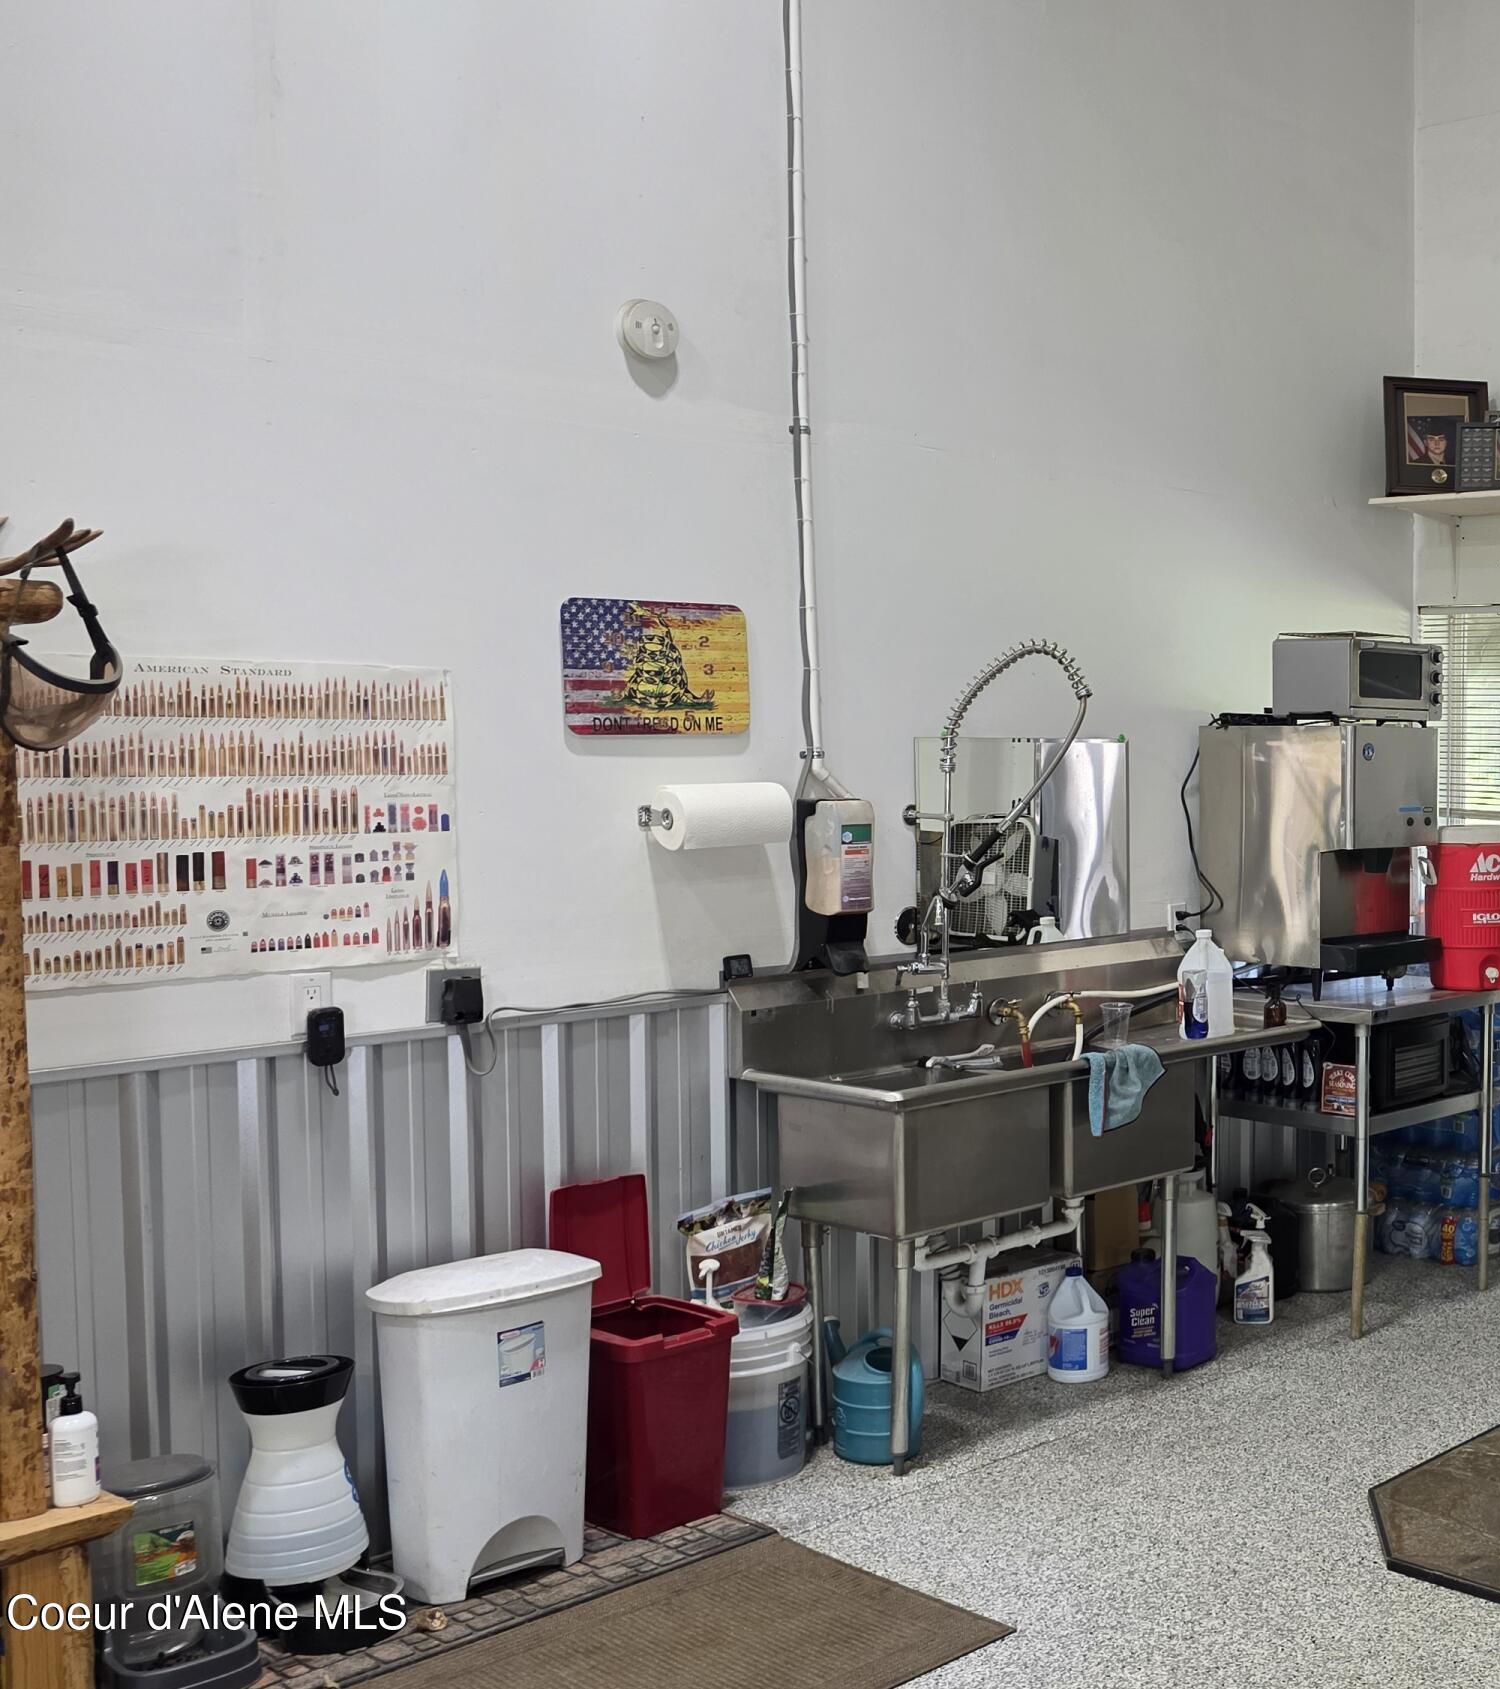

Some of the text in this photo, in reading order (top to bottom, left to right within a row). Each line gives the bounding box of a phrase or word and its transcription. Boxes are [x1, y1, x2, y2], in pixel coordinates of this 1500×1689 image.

[698, 635, 710, 648] 2
[134, 663, 293, 677] AMERICAN STANDARD
[703, 663, 714, 676] 3
[682, 717, 701, 732] ON
[705, 717, 724, 731] ME
[1442, 1223, 1455, 1234] 40
[705, 1229, 756, 1252] Chicken Jerky
[988, 1278, 1024, 1301] HDX
[989, 1296, 1023, 1311] Germicidal
[1130, 1307, 1156, 1318] Super
[1131, 1316, 1155, 1327] Clean
